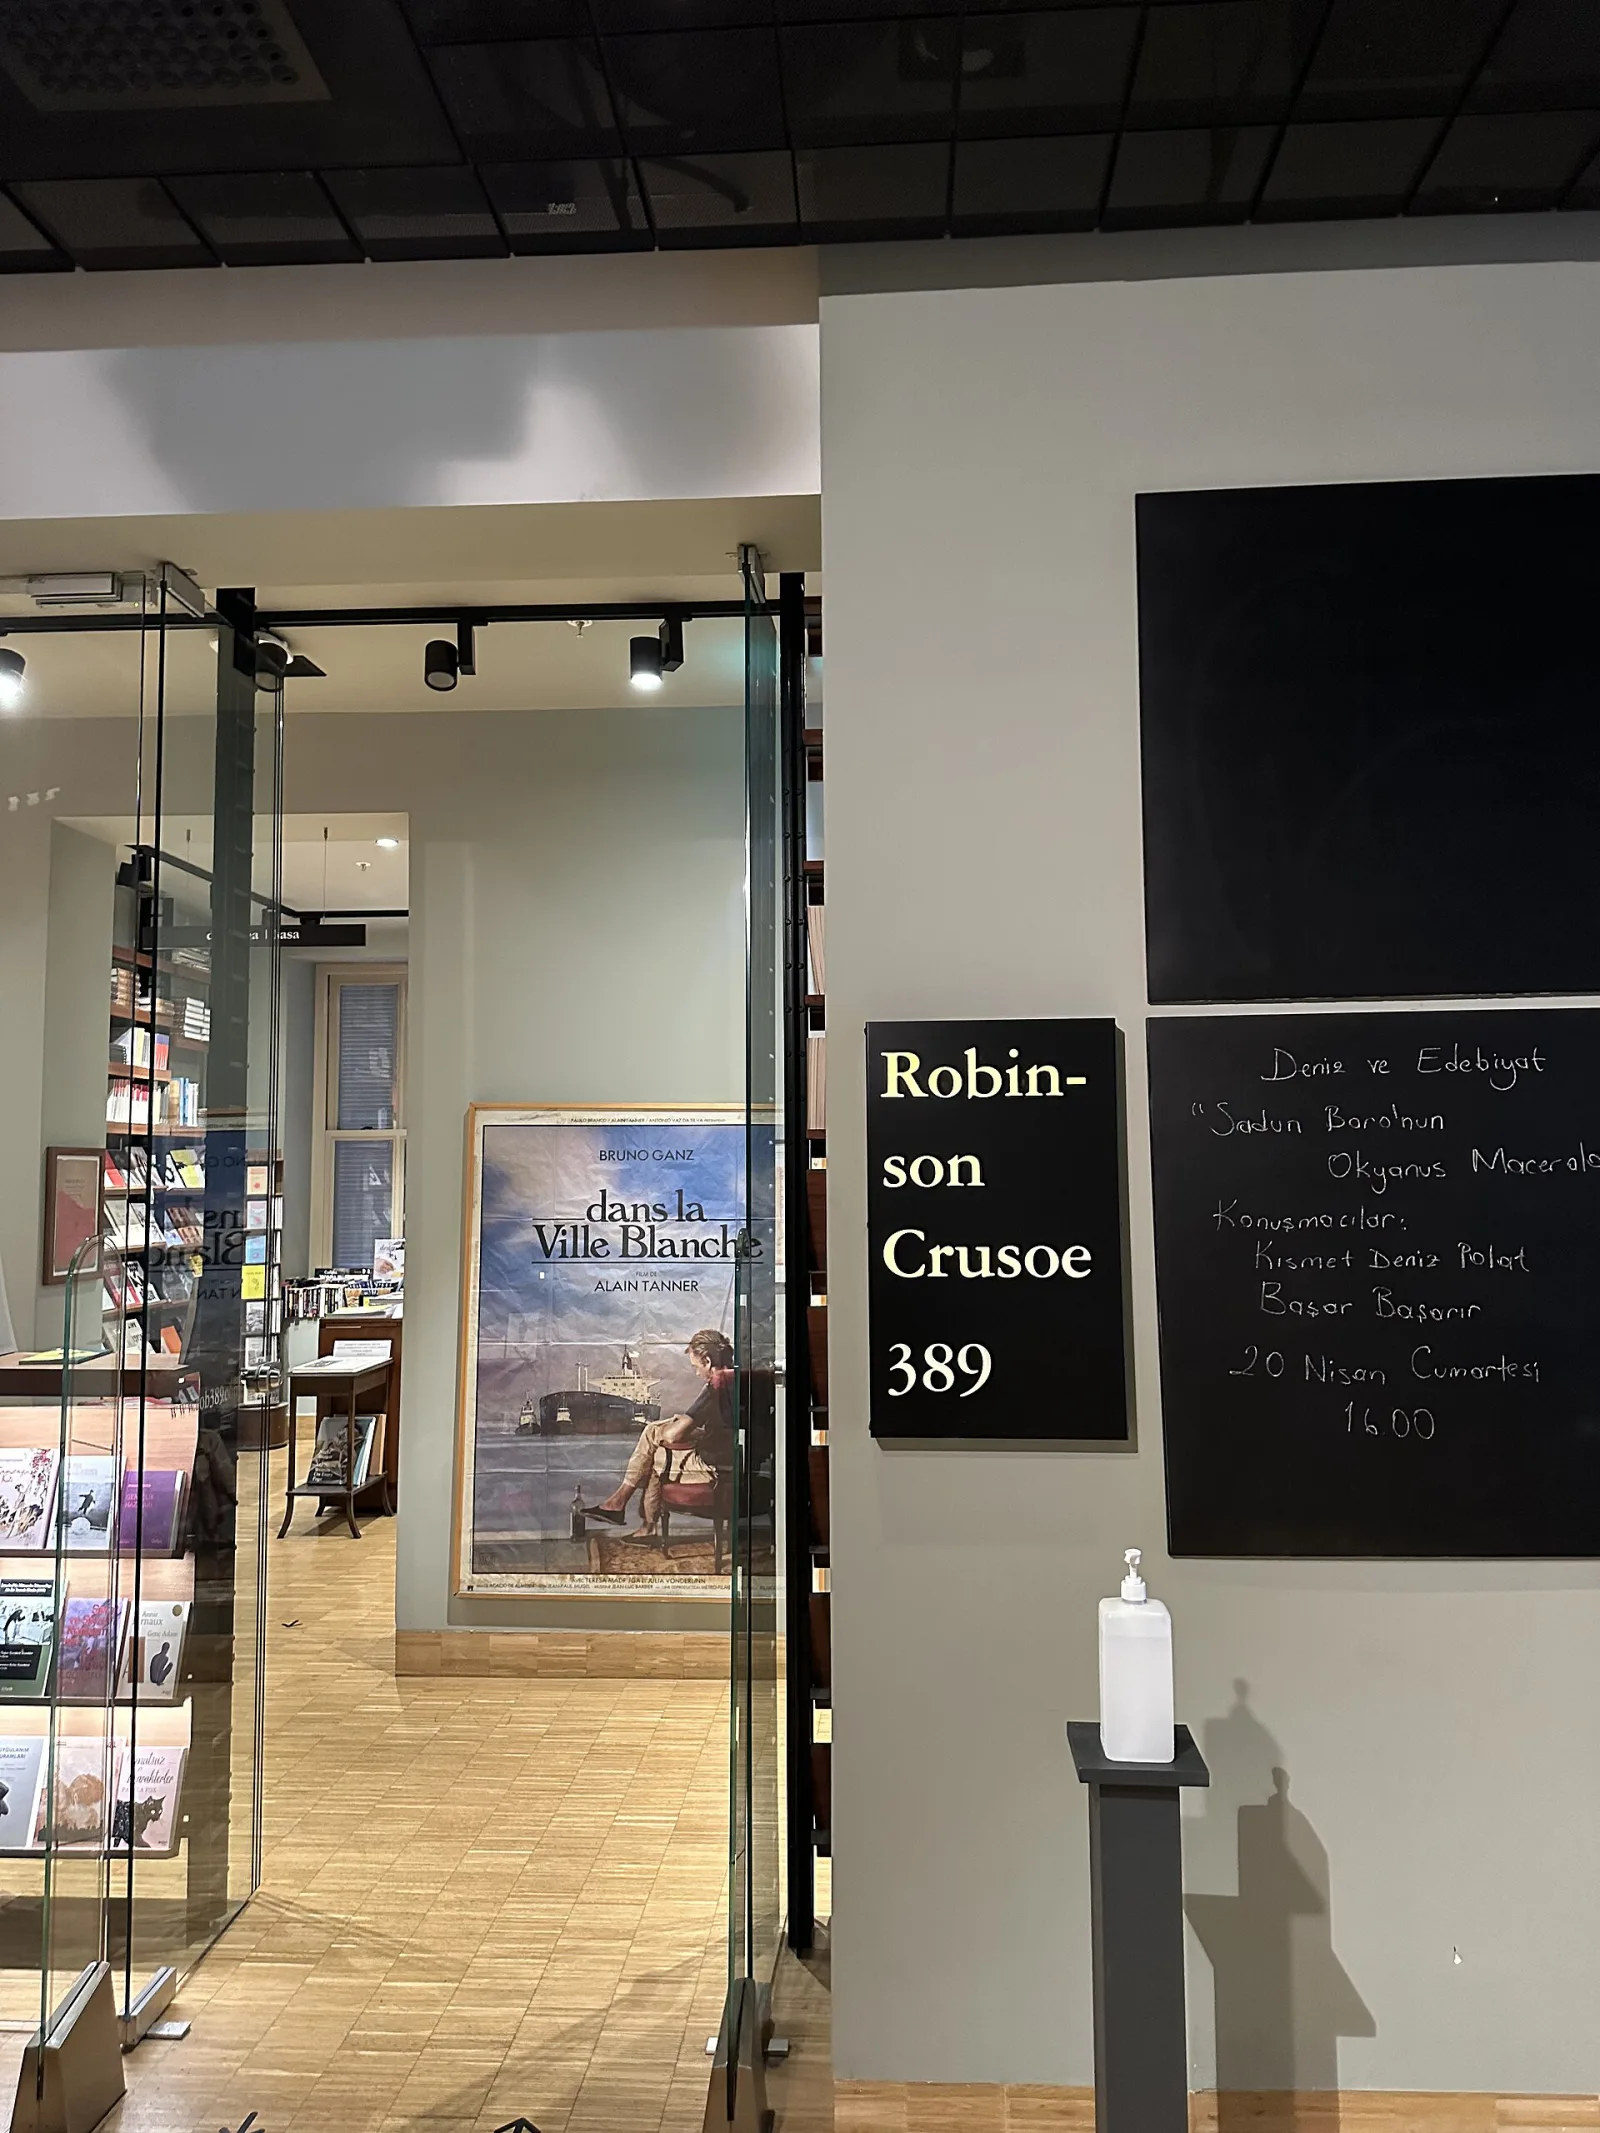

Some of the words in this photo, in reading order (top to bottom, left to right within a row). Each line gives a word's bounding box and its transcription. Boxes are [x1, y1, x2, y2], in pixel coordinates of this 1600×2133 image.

[881, 1046, 1087, 1099] Robin-
[1261, 1047, 1346, 1081] Deniz
[1367, 1056, 1391, 1075] ve
[1416, 1043, 1547, 1091] Edebiyat
[599, 1149, 649, 1161] BRUNO
[652, 1149, 694, 1161] GANZ
[883, 1154, 985, 1188] son
[1328, 1149, 1446, 1194] Okyanus
[586, 1188, 668, 1223] dans
[675, 1188, 708, 1223] la
[532, 1223, 611, 1260] Ville
[619, 1223, 764, 1260] Blanche
[882, 1228, 1092, 1279] Crusoe
[1369, 1249, 1441, 1269] Deniz
[1457, 1241, 1531, 1273] Polat
[594, 1280, 638, 1292] ALAIN
[641, 1280, 699, 1292] TANNER
[1260, 1280, 1353, 1318] Başar
[887, 1343, 992, 1398] 389
[1228, 1345, 1285, 1378] 20
[1305, 1354, 1387, 1385] Nisan
[1411, 1345, 1540, 1384] Cumartesi
[133, 1617, 164, 1626] rnaux
